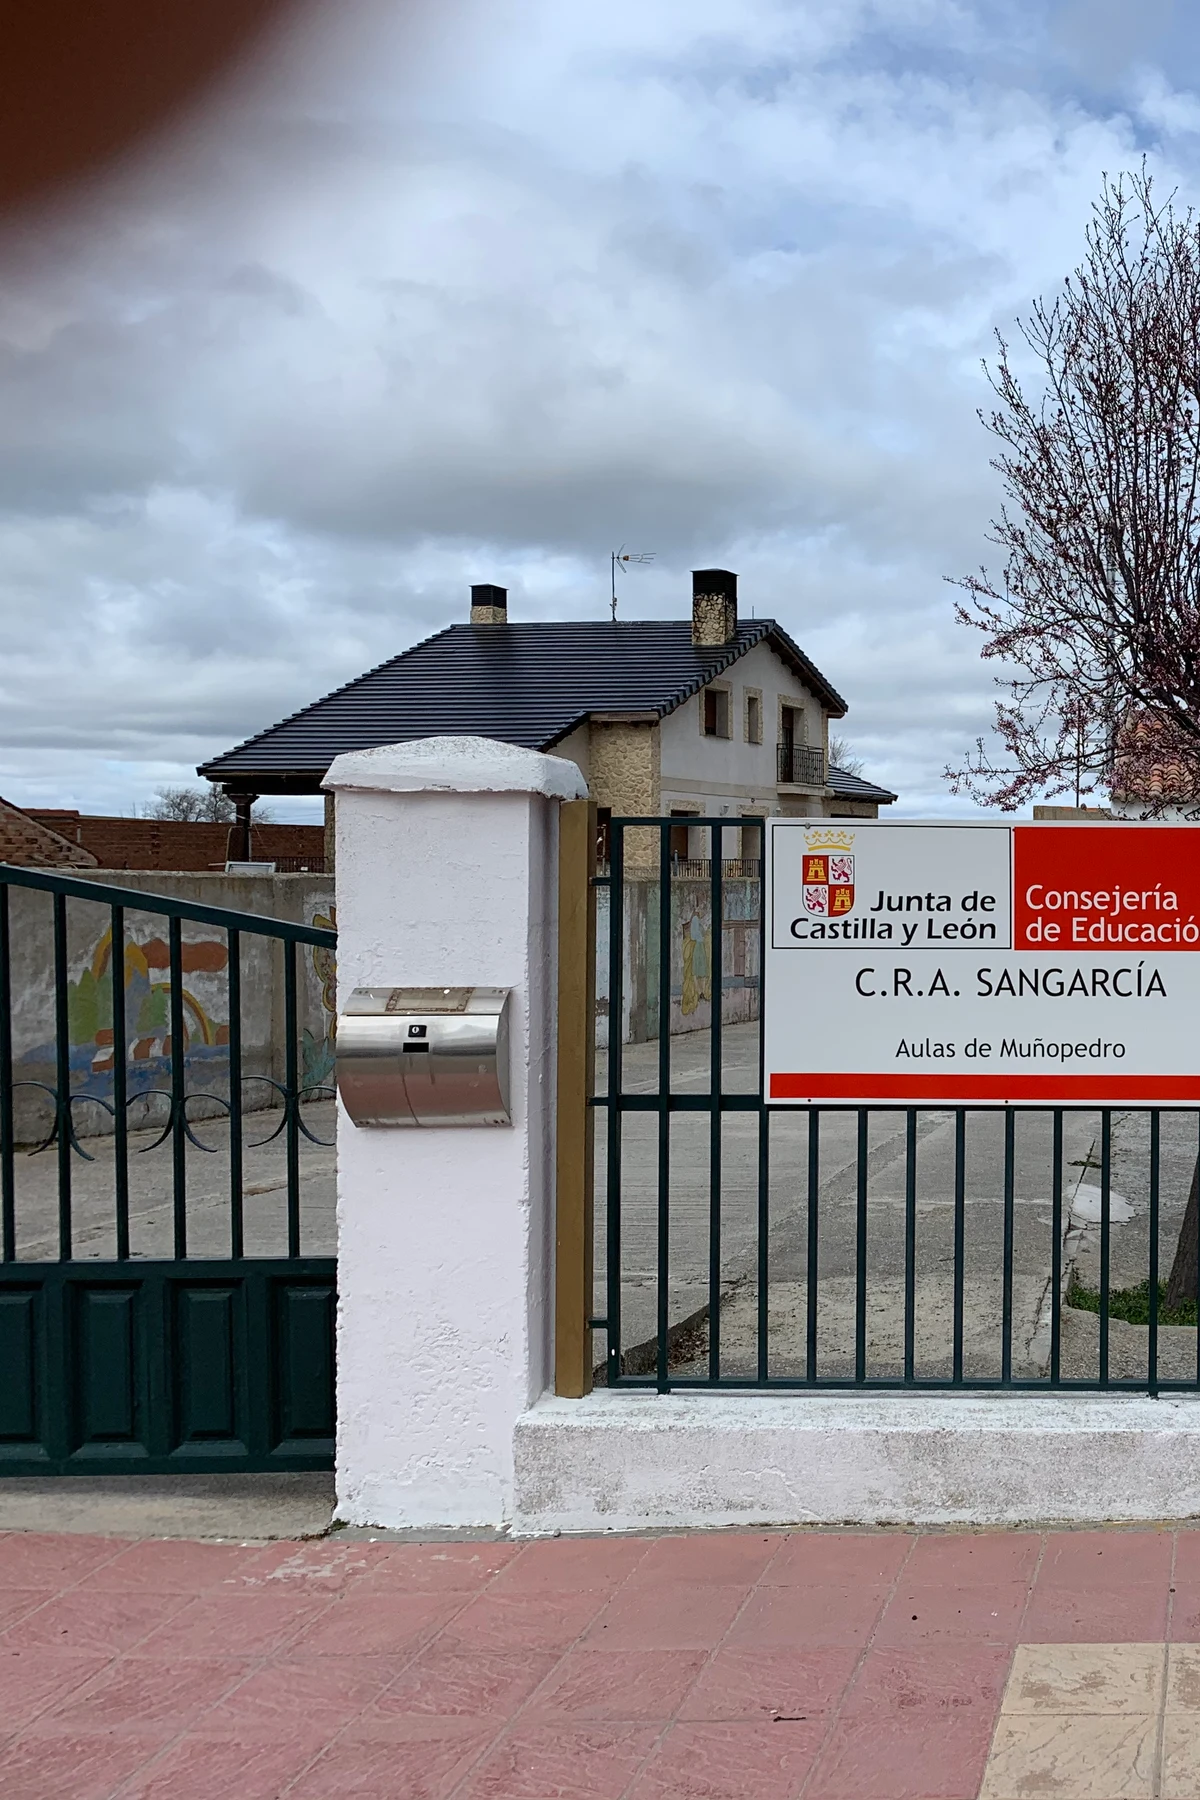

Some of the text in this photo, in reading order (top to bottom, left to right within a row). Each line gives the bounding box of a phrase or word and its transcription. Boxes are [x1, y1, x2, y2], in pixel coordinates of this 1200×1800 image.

[870, 890, 996, 912] Junta de
[1025, 883, 1178, 916] Consejería
[790, 917, 996, 947] Castilla y León
[1025, 916, 1061, 942] de
[855, 960, 1168, 998] C.R.A. SANGARCÍA
[895, 1037, 1126, 1063] Aulas de Muñopedro
